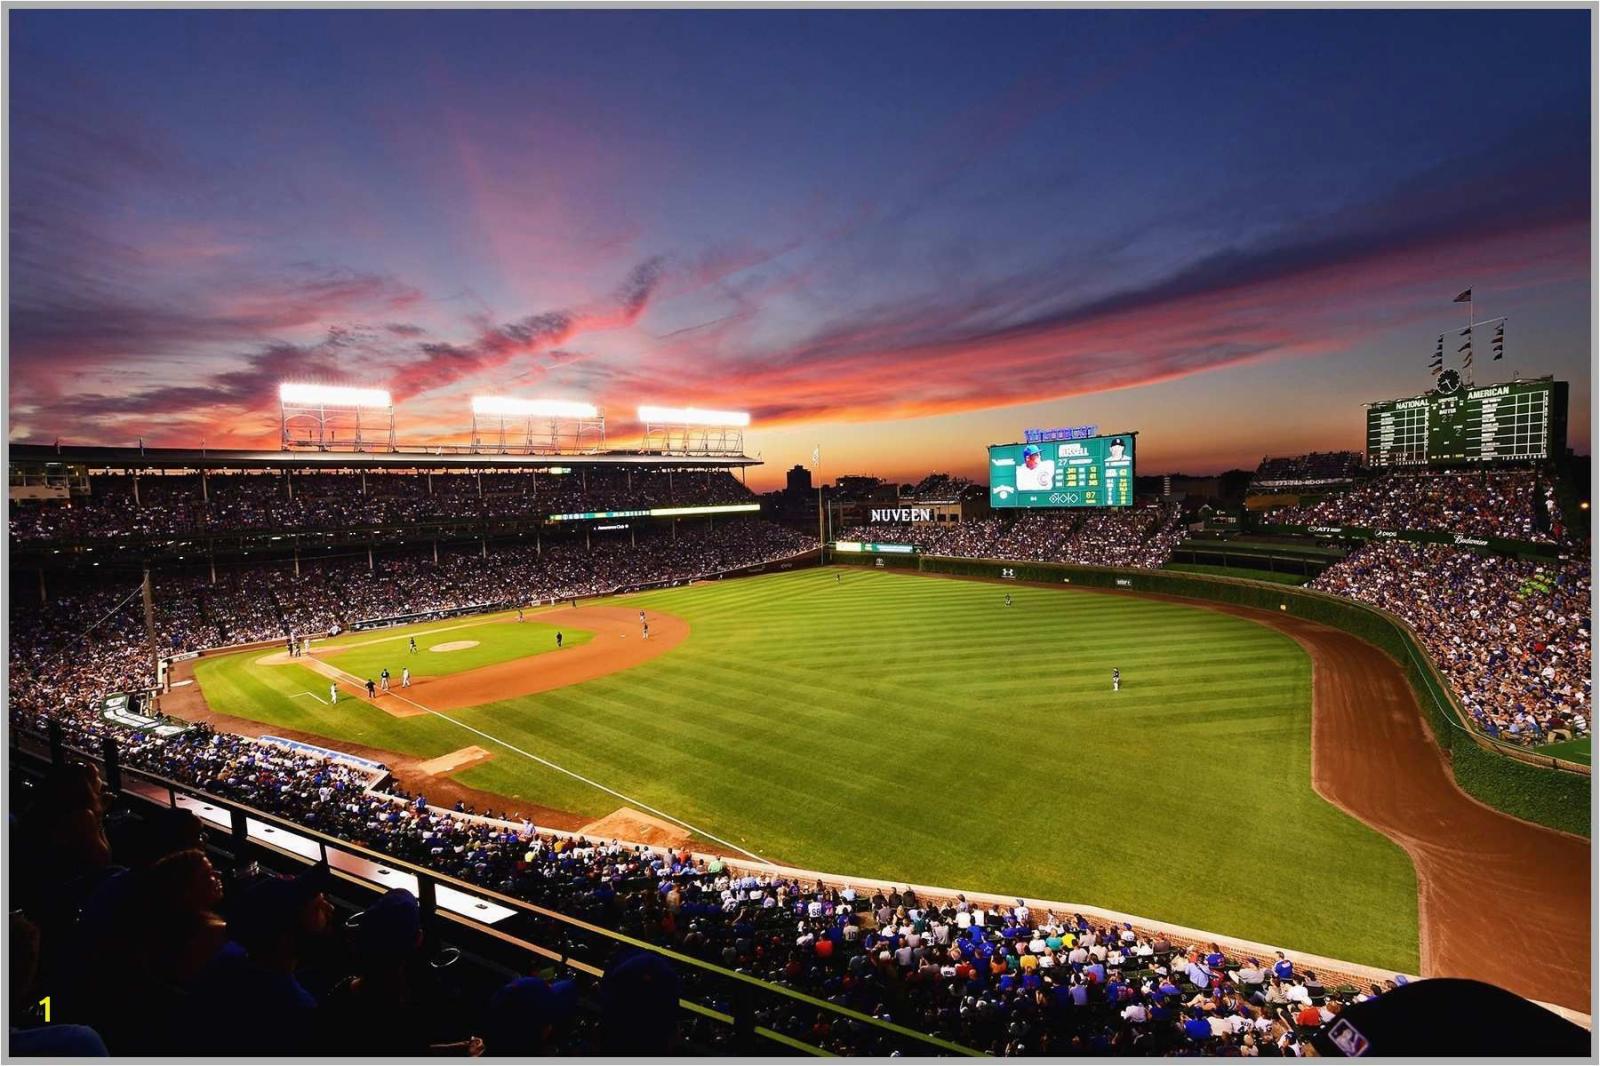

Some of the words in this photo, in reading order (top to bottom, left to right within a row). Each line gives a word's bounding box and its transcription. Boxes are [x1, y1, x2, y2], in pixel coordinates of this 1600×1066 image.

[1467, 387, 1510, 400] AMERICAN
[1396, 398, 1430, 410] NATIONAL
[1455, 428, 1462, 437] 2
[1058, 458, 1068, 466] 27
[1086, 491, 1096, 499] 87
[871, 508, 931, 522] NUVEEN
[1453, 534, 1489, 547] Budweiser
